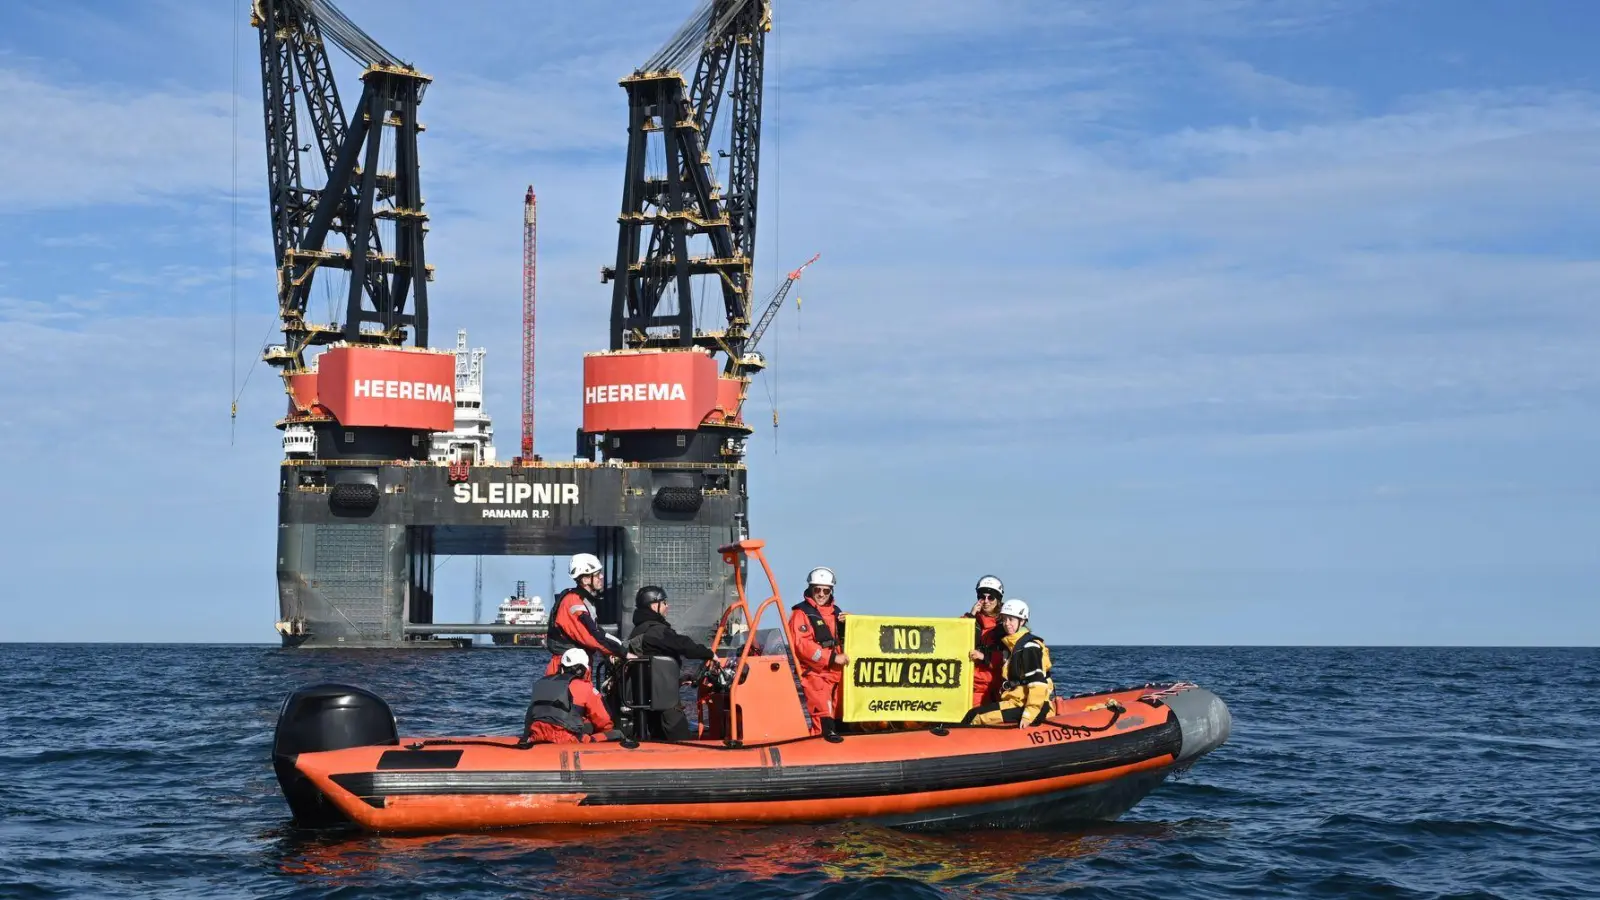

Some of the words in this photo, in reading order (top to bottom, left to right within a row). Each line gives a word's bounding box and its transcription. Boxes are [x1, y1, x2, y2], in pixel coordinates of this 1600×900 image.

[354, 379, 453, 403] HEEREMA
[585, 383, 686, 404] HEEREMA
[453, 482, 579, 504] SLEIPNIR
[482, 509, 528, 518] PANAMA
[532, 509, 550, 518] R.P.
[893, 628, 921, 650] NO
[859, 661, 903, 683] NEW
[908, 662, 956, 685] GAS!
[868, 699, 941, 713] GREENPEACE
